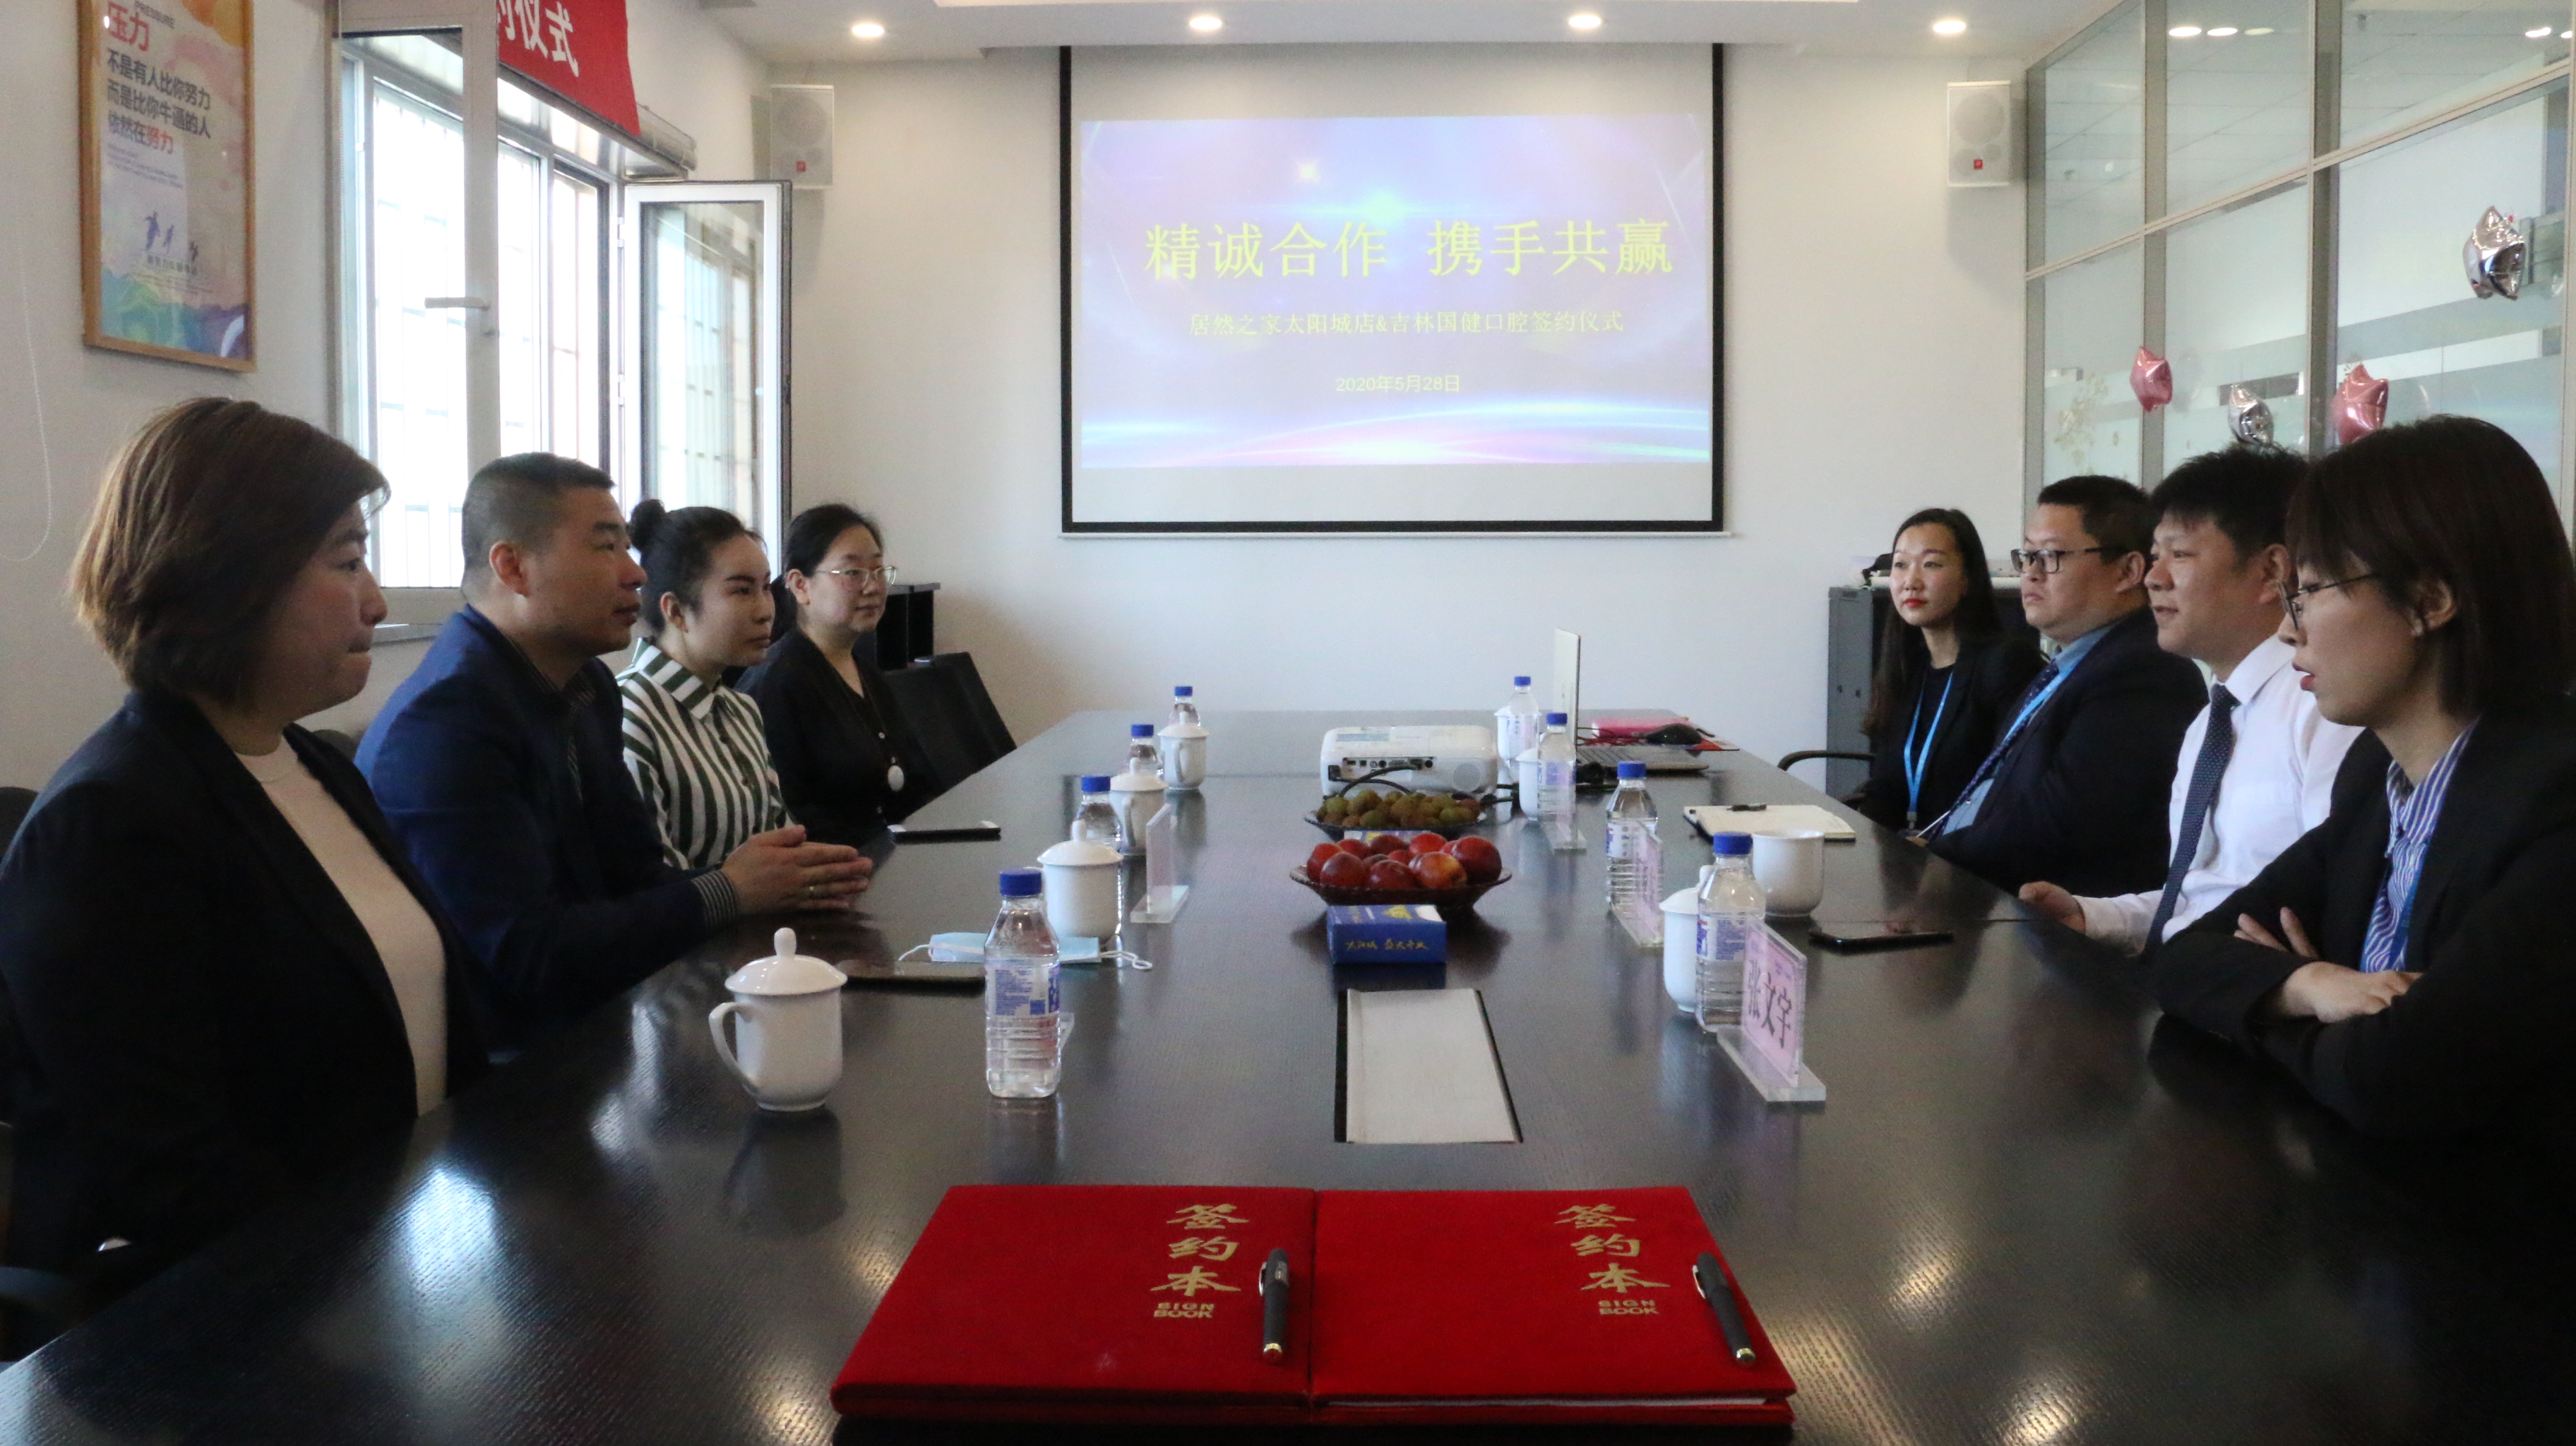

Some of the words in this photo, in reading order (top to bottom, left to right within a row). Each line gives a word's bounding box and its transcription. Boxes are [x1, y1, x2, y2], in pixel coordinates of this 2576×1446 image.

[107, 1, 150, 52] 压力
[107, 48, 210, 111] 不是有人比你努力
[107, 78, 210, 139] 而是比你牛逼的人
[108, 109, 174, 155] 依然在努力
[1145, 222, 1388, 280] 精诚合作
[1426, 218, 1673, 276] 携手共赢
[1188, 310, 1624, 337] 居然之家太阳城店&吉林国健口腔签约仪式
[1335, 374, 1461, 393] 2020年5月28日
[1150, 1203, 1250, 1297] 签约本
[1554, 1203, 1671, 1293] 签约本
[1153, 1310, 1213, 1319] BOOK
[1157, 1302, 1215, 1311] SIGN
[1599, 1307, 1659, 1315] BOOK
